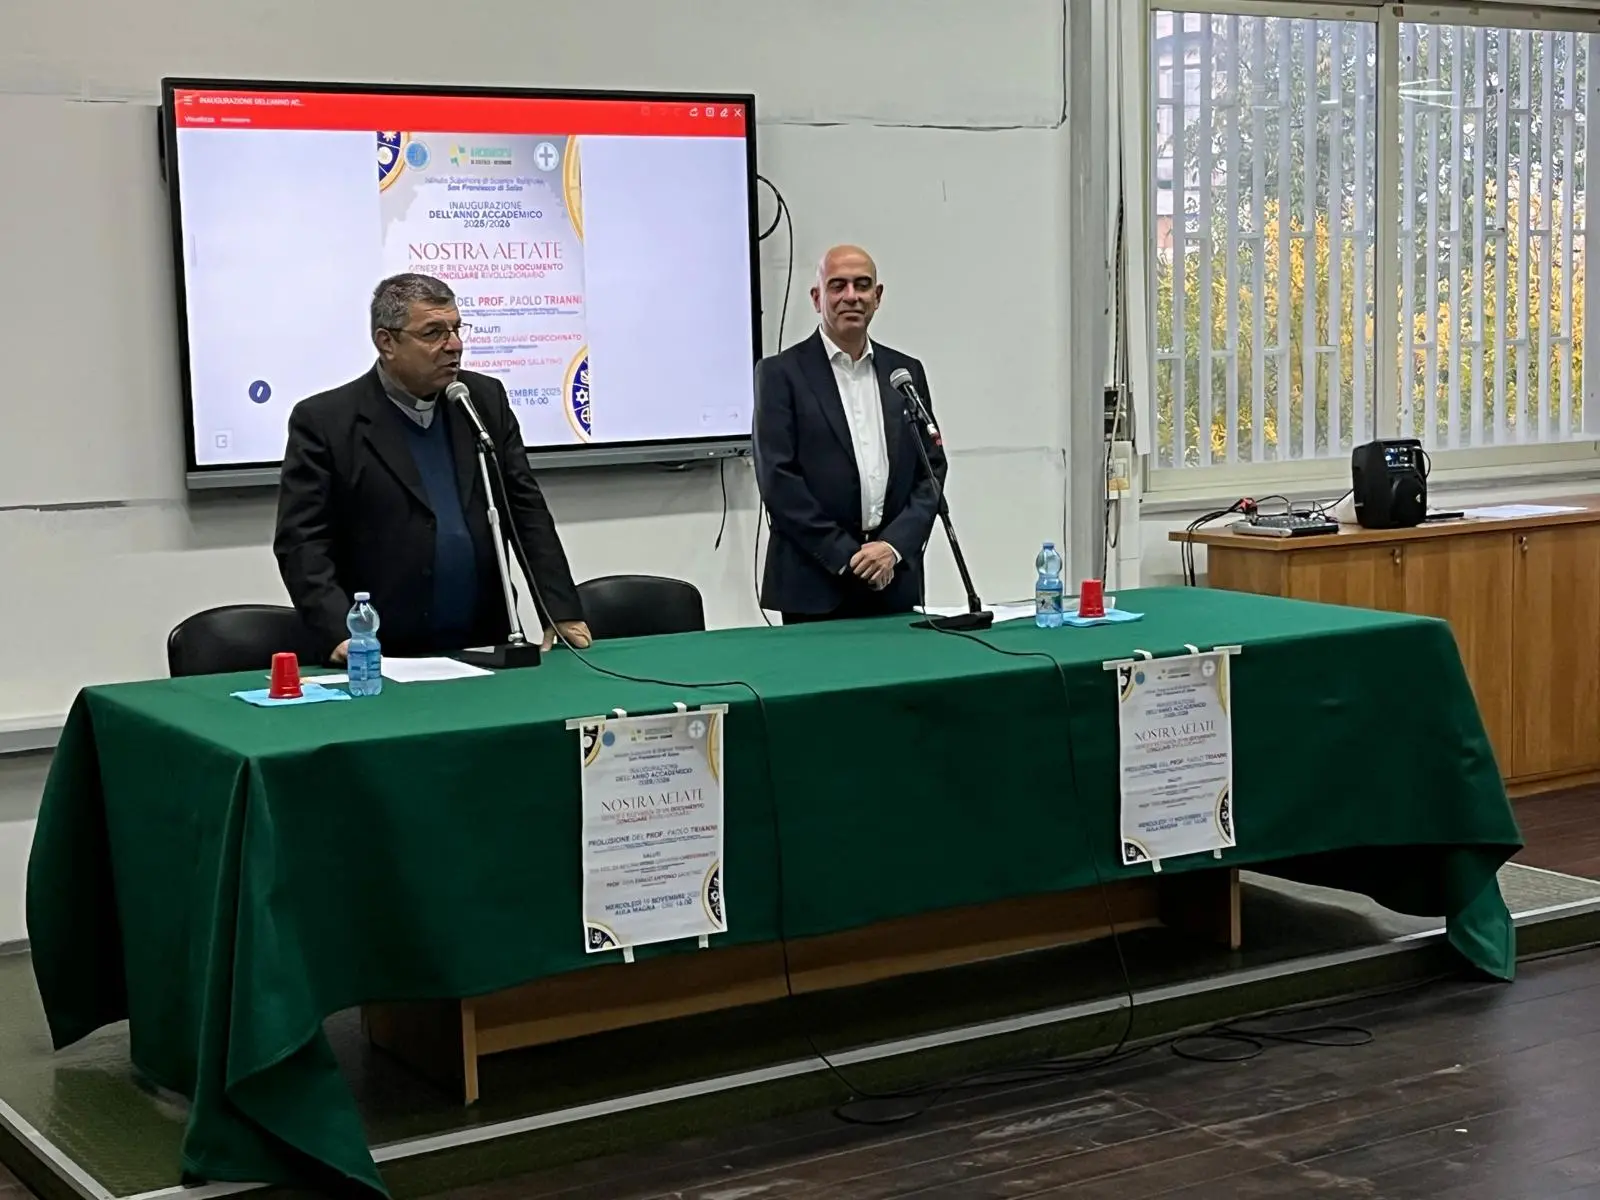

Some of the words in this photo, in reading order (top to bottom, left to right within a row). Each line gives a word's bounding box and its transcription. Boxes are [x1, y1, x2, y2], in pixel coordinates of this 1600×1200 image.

[449, 201, 523, 210] INAUGURAZIONE
[429, 210, 480, 219] DELL'ANNO
[481, 210, 543, 219] ACCADEMICO
[463, 219, 511, 228] 2025/2026
[408, 242, 489, 260] NOSTRA
[493, 241, 563, 260] AETATE
[408, 263, 438, 273] GENESI
[446, 264, 489, 272] RILEVANZA
[513, 263, 564, 271] DOCUMENTO
[431, 271, 480, 280] CONCILIARE
[481, 271, 546, 279] RIVOLUZIONARIO
[457, 297, 476, 307] DEL
[510, 296, 542, 306] PAOLO
[544, 295, 584, 305] TRIANNI
[473, 326, 501, 334] SALUTI
[464, 361, 491, 369] EMILIO
[491, 359, 526, 368] ANTONIO
[508, 388, 539, 398] EMBRE
[601, 794, 655, 813] NOSTRA
[657, 787, 704, 806] AETATE
[588, 835, 630, 848] PROLUSIONE
[690, 824, 718, 834] TRIANNI
